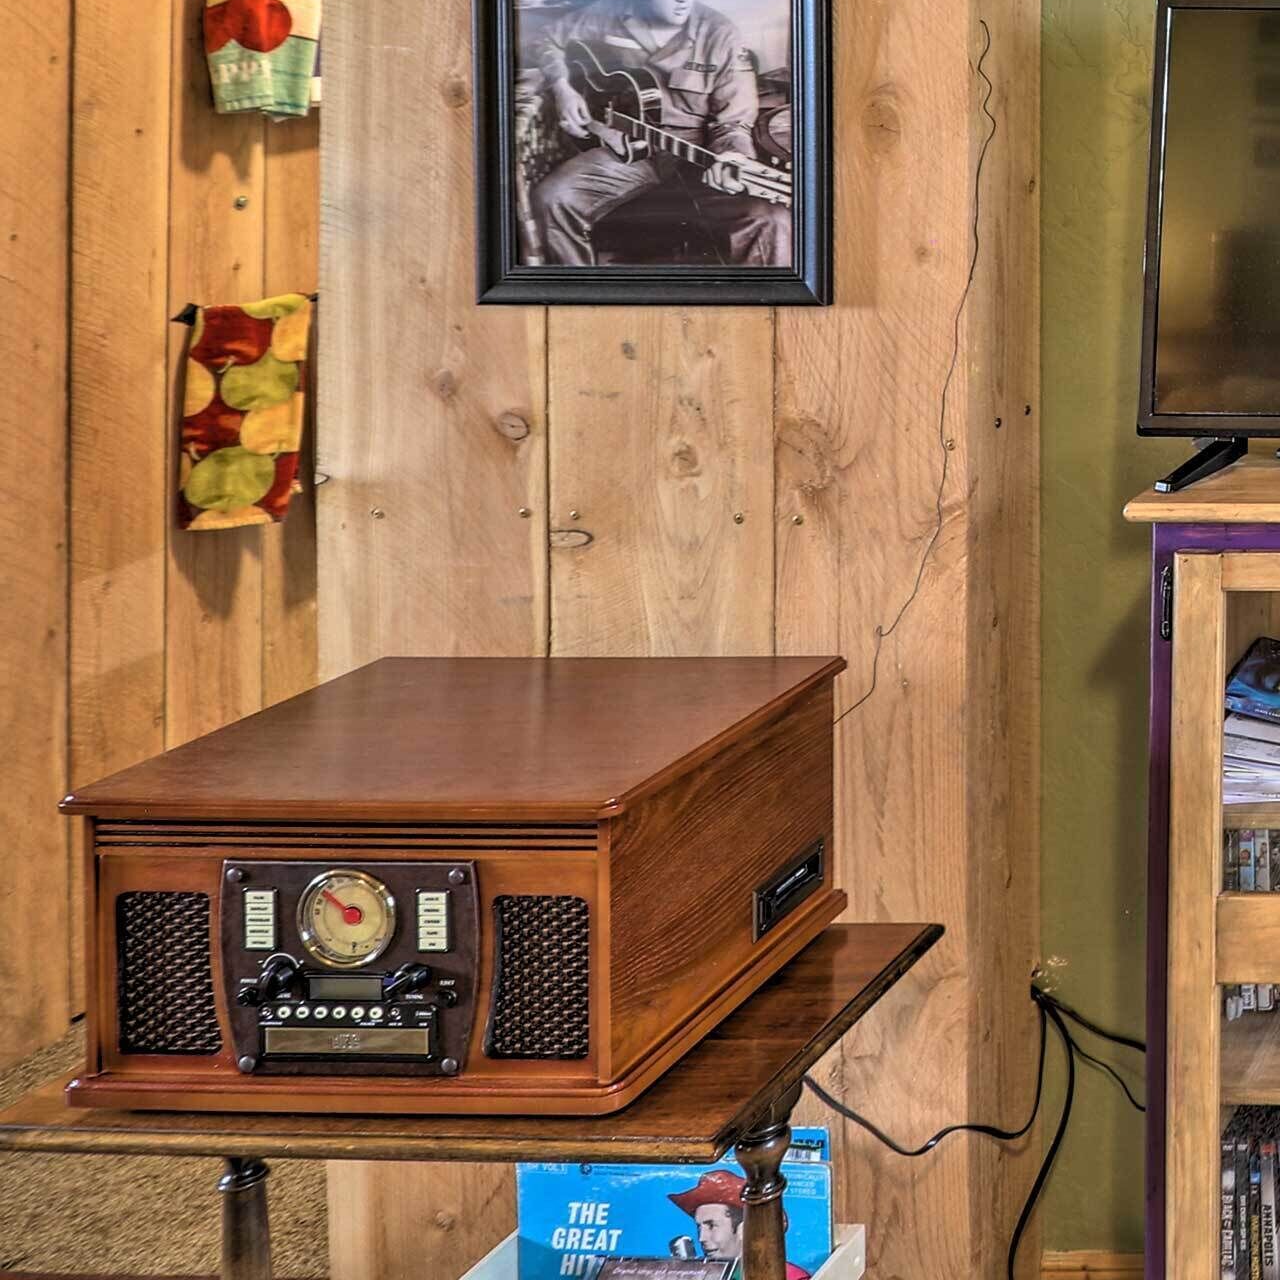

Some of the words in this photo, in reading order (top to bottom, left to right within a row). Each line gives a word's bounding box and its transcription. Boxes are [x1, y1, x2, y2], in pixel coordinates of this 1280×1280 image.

[567, 1201, 610, 1225] THE
[551, 1227, 622, 1252] GREAT
[1261, 1204, 1275, 1267] ANNAPOLIS
[560, 1253, 605, 1278] HIT
